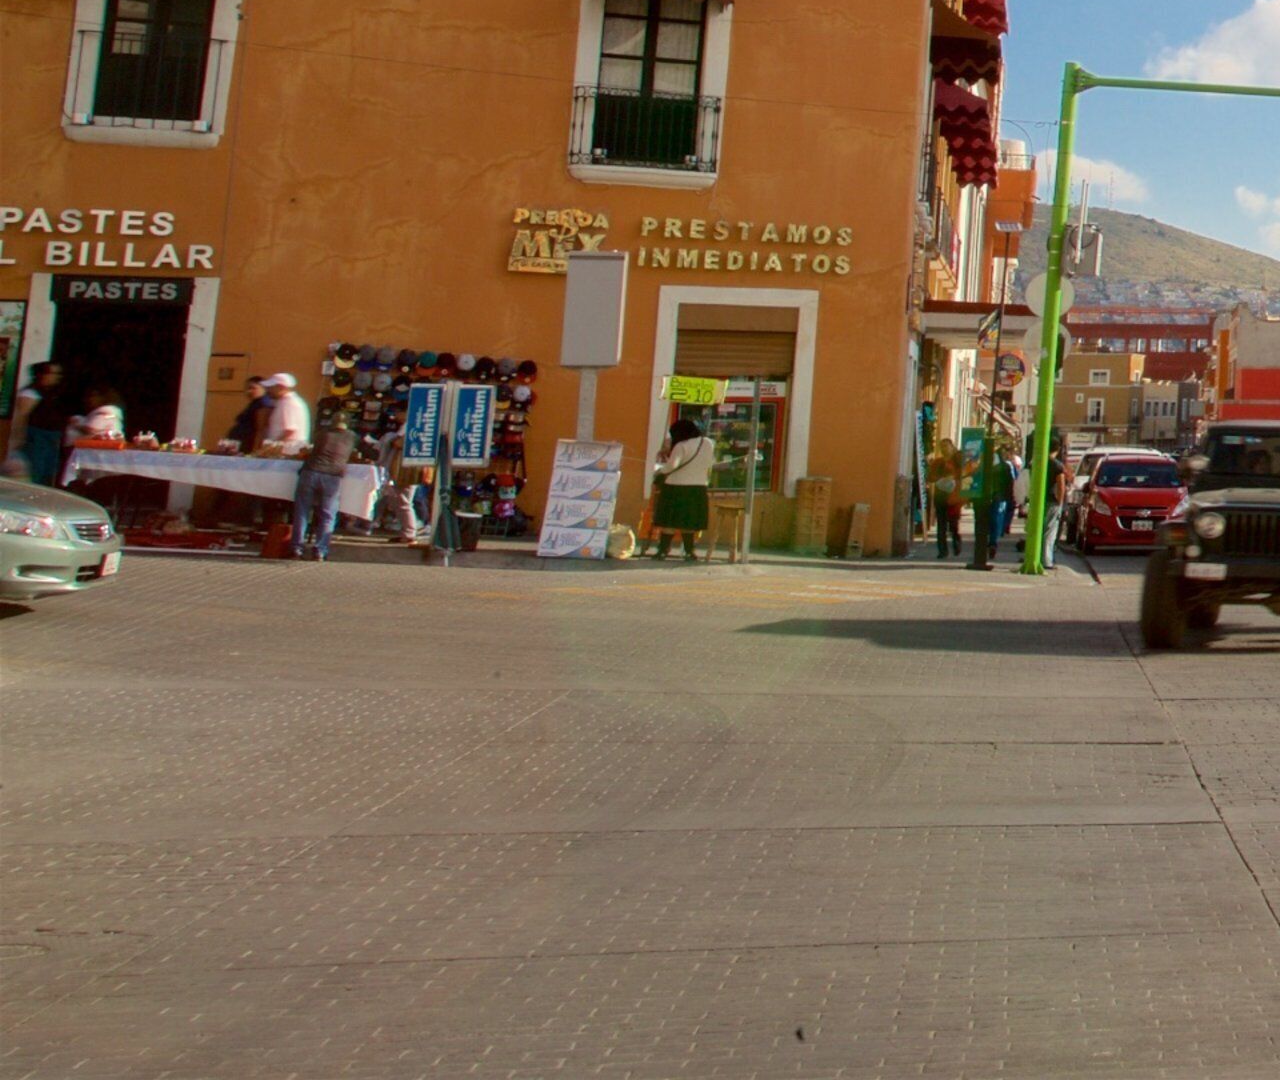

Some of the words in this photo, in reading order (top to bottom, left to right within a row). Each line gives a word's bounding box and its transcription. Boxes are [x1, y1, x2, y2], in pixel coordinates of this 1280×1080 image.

[0, 206, 175, 236] PASTES
[641, 216, 853, 246] PRESTAMOS
[45, 241, 214, 269] BILLAR
[637, 247, 851, 275] INMEDIATOS
[69, 280, 178, 300] PASTES
[417, 389, 439, 457] infinitum
[465, 390, 487, 457] infinitum
